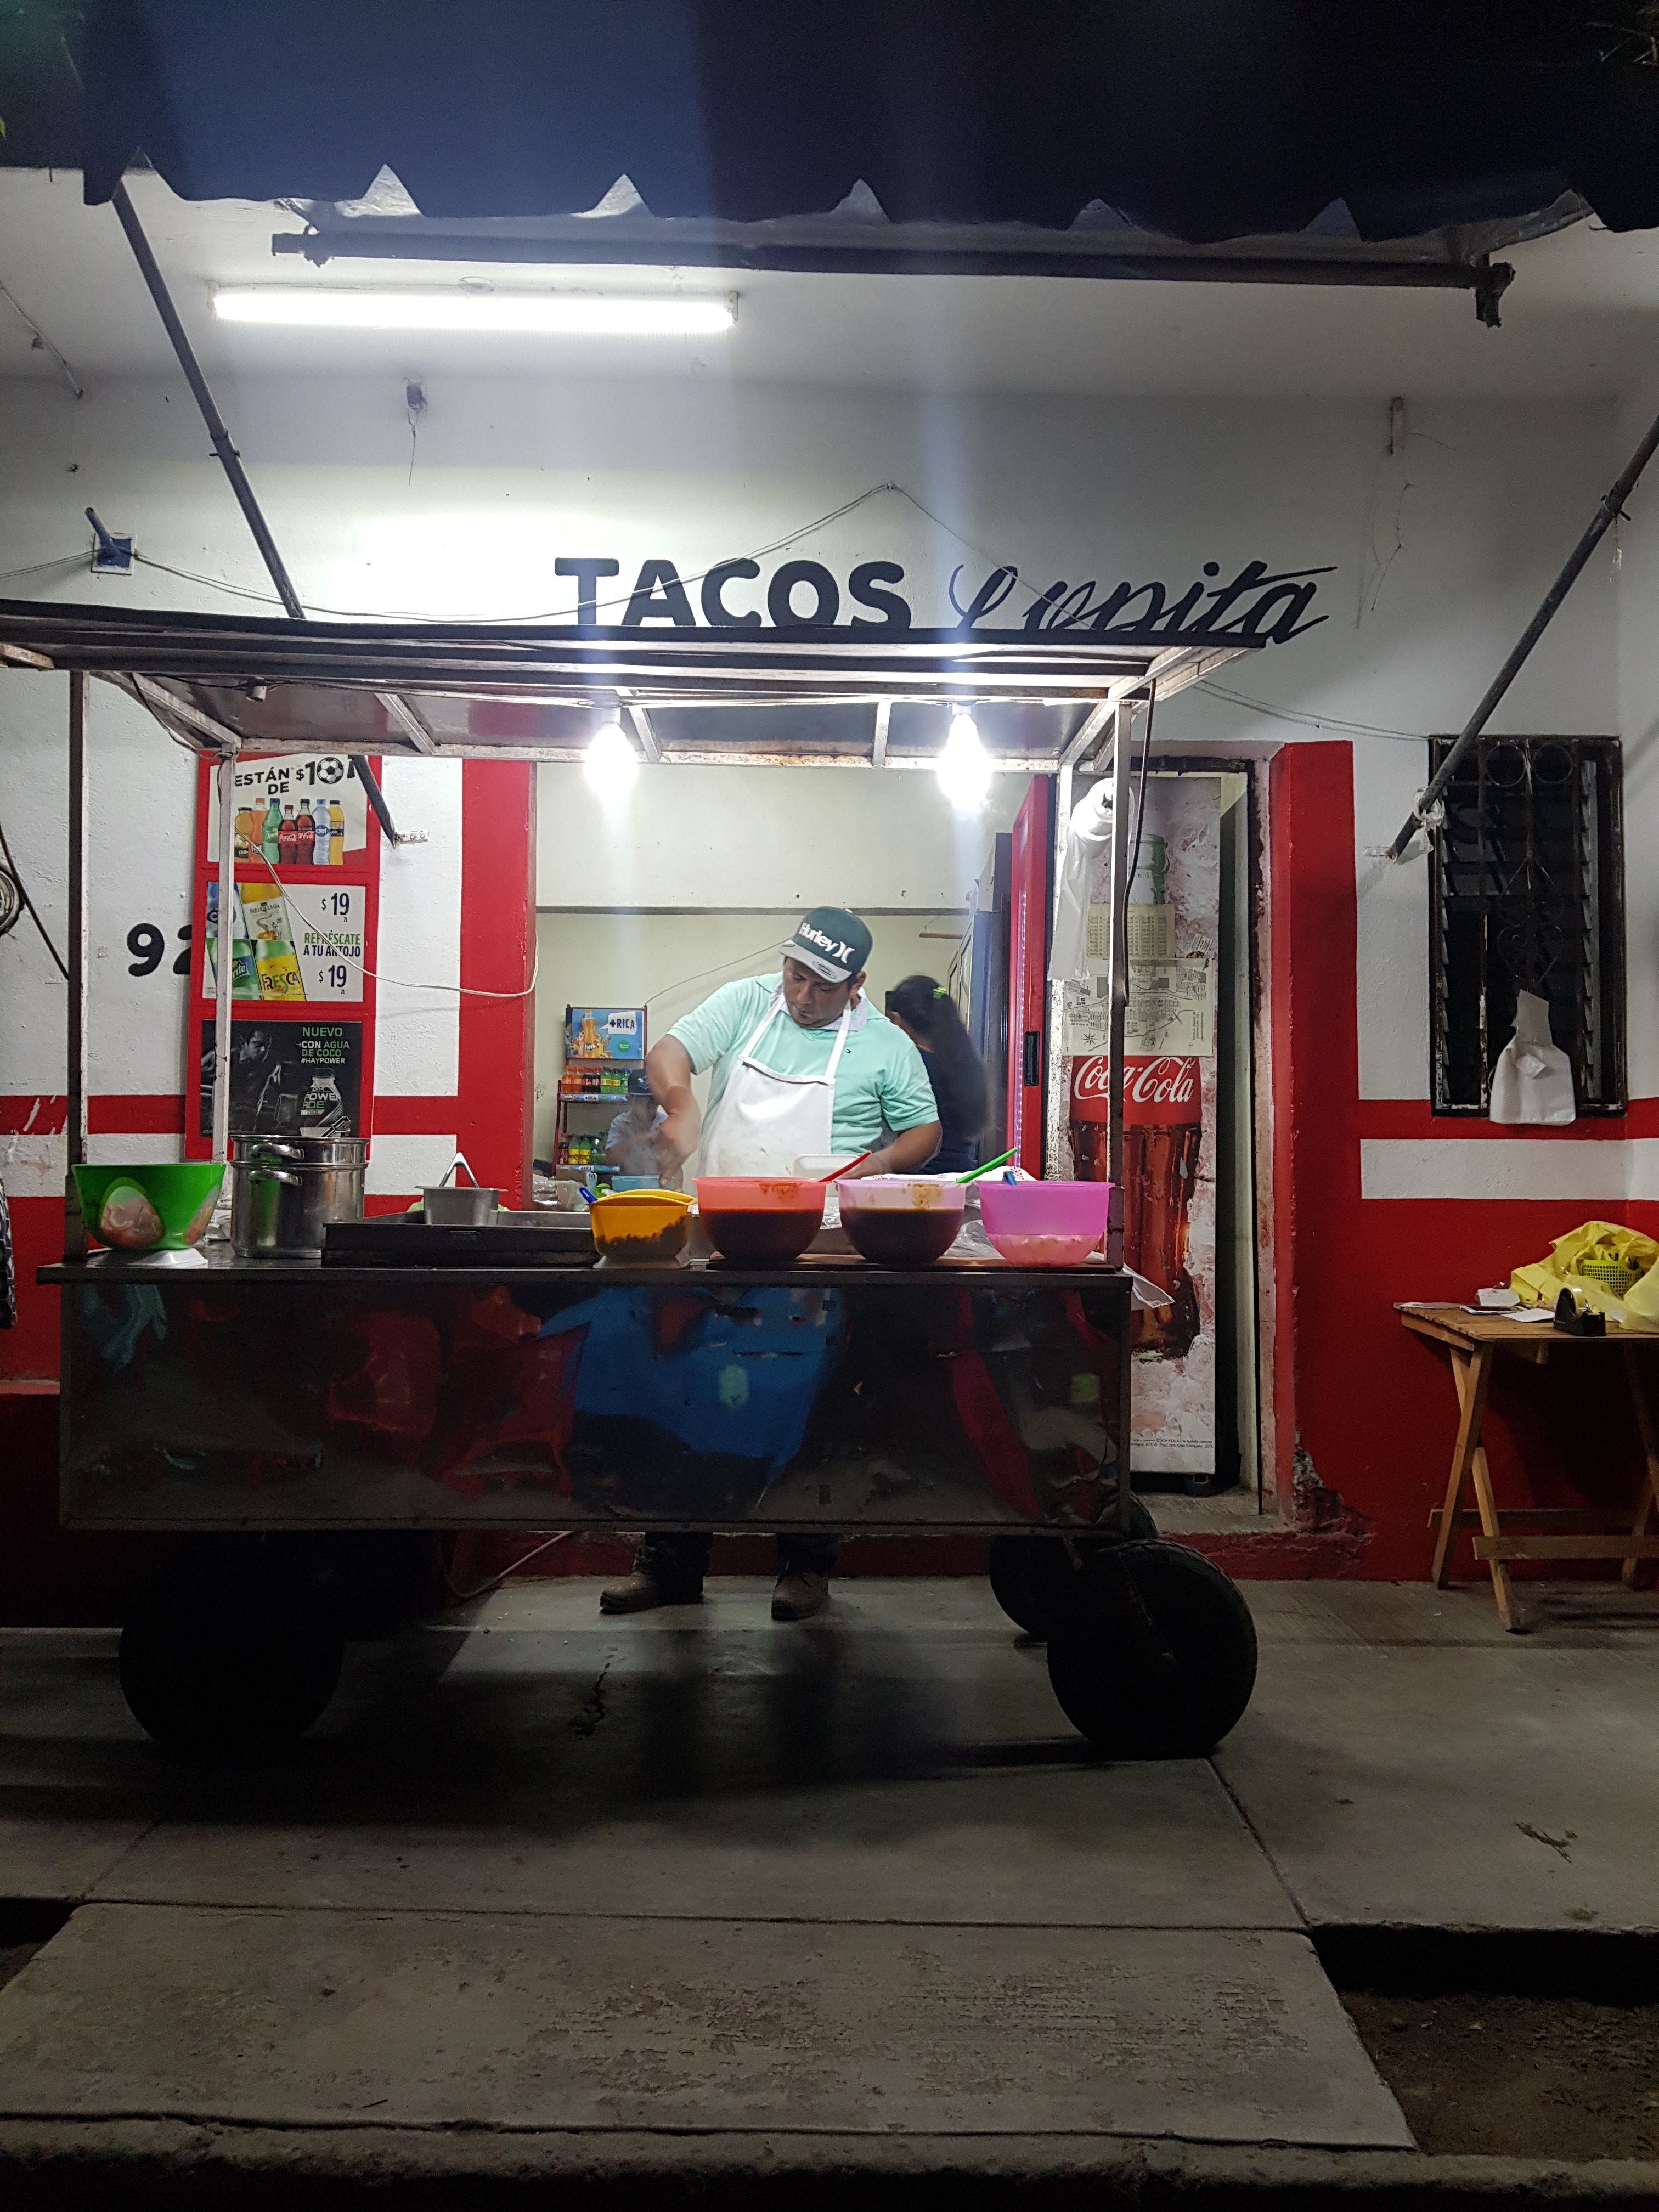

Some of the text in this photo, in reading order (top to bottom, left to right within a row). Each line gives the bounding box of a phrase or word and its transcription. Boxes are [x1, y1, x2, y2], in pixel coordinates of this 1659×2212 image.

[554, 557, 911, 627] TACOS
[268, 781, 289, 795] DE
[304, 930, 361, 945] REFRÉSCATE
[798, 922, 839, 952] Hurley
[303, 945, 361, 957] A TU ANTOJO
[261, 971, 300, 995] FRESCA
[302, 1026, 343, 1037] NUEVO
[317, 1049, 342, 1057] COCO
[302, 1101, 325, 1109] ADE
